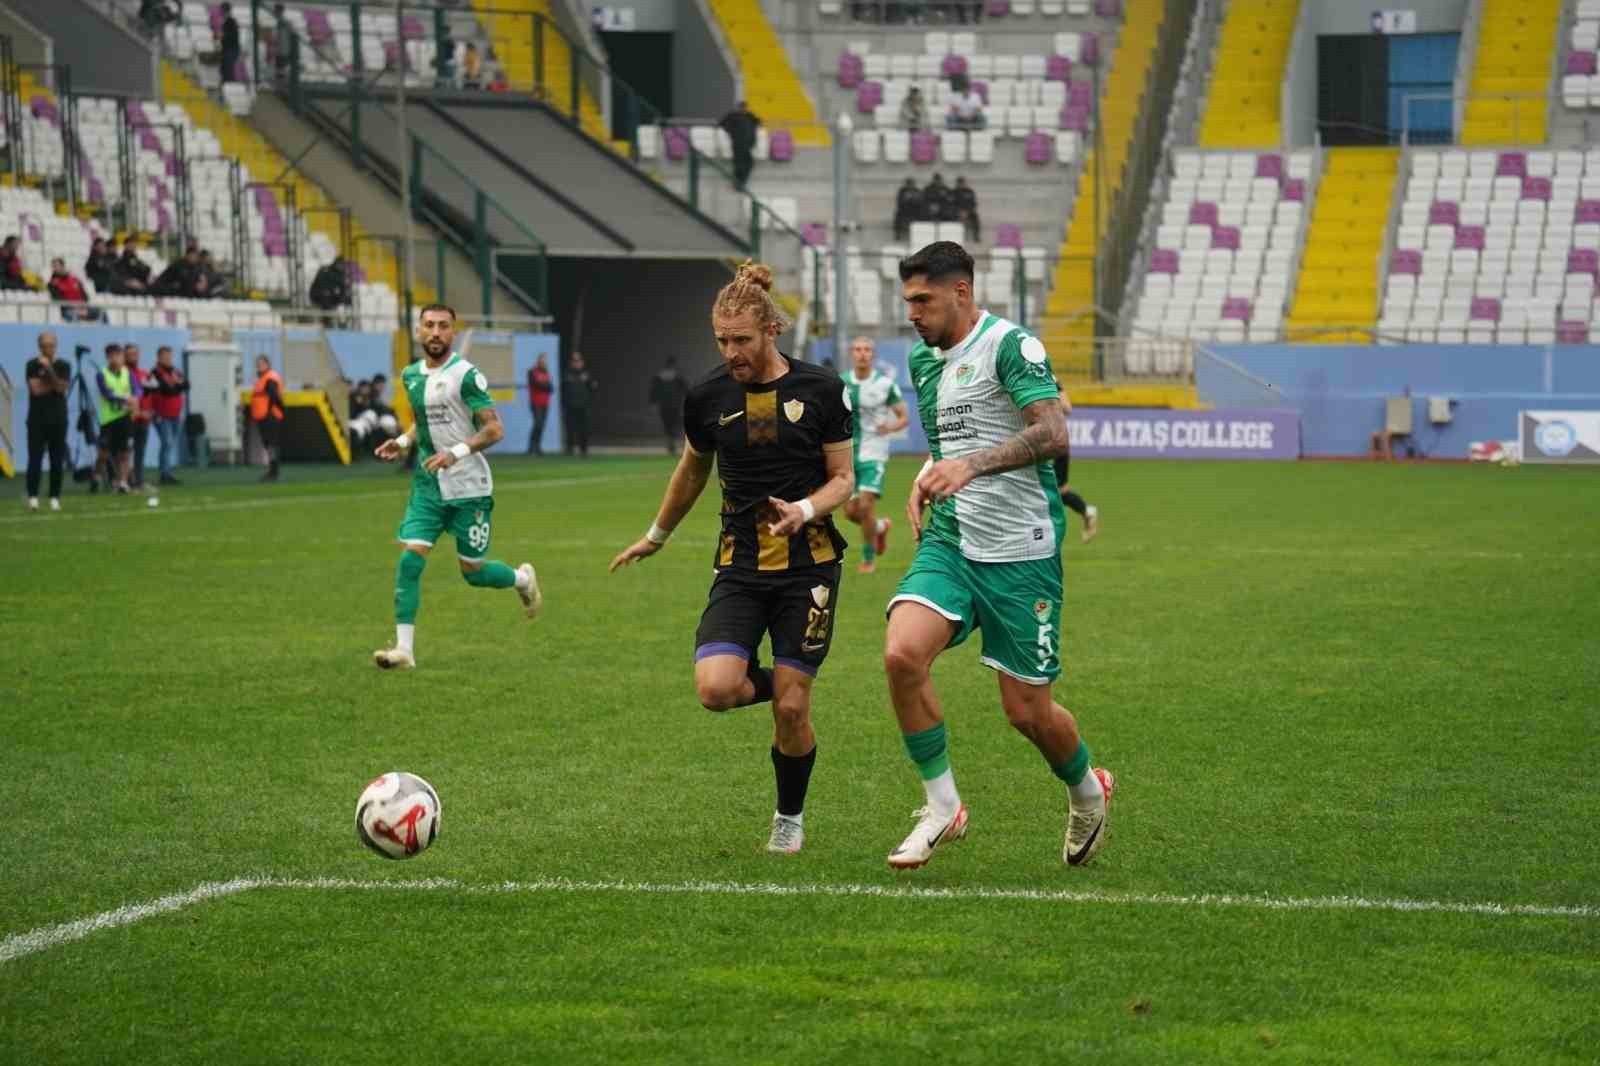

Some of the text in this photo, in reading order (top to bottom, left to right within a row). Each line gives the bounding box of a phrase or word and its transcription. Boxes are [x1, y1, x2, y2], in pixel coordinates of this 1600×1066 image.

[1098, 419, 1169, 452] ALTAŞ
[1171, 420, 1274, 449] COLLEGE
[468, 522, 490, 550] 99
[1037, 623, 1054, 661] 5
